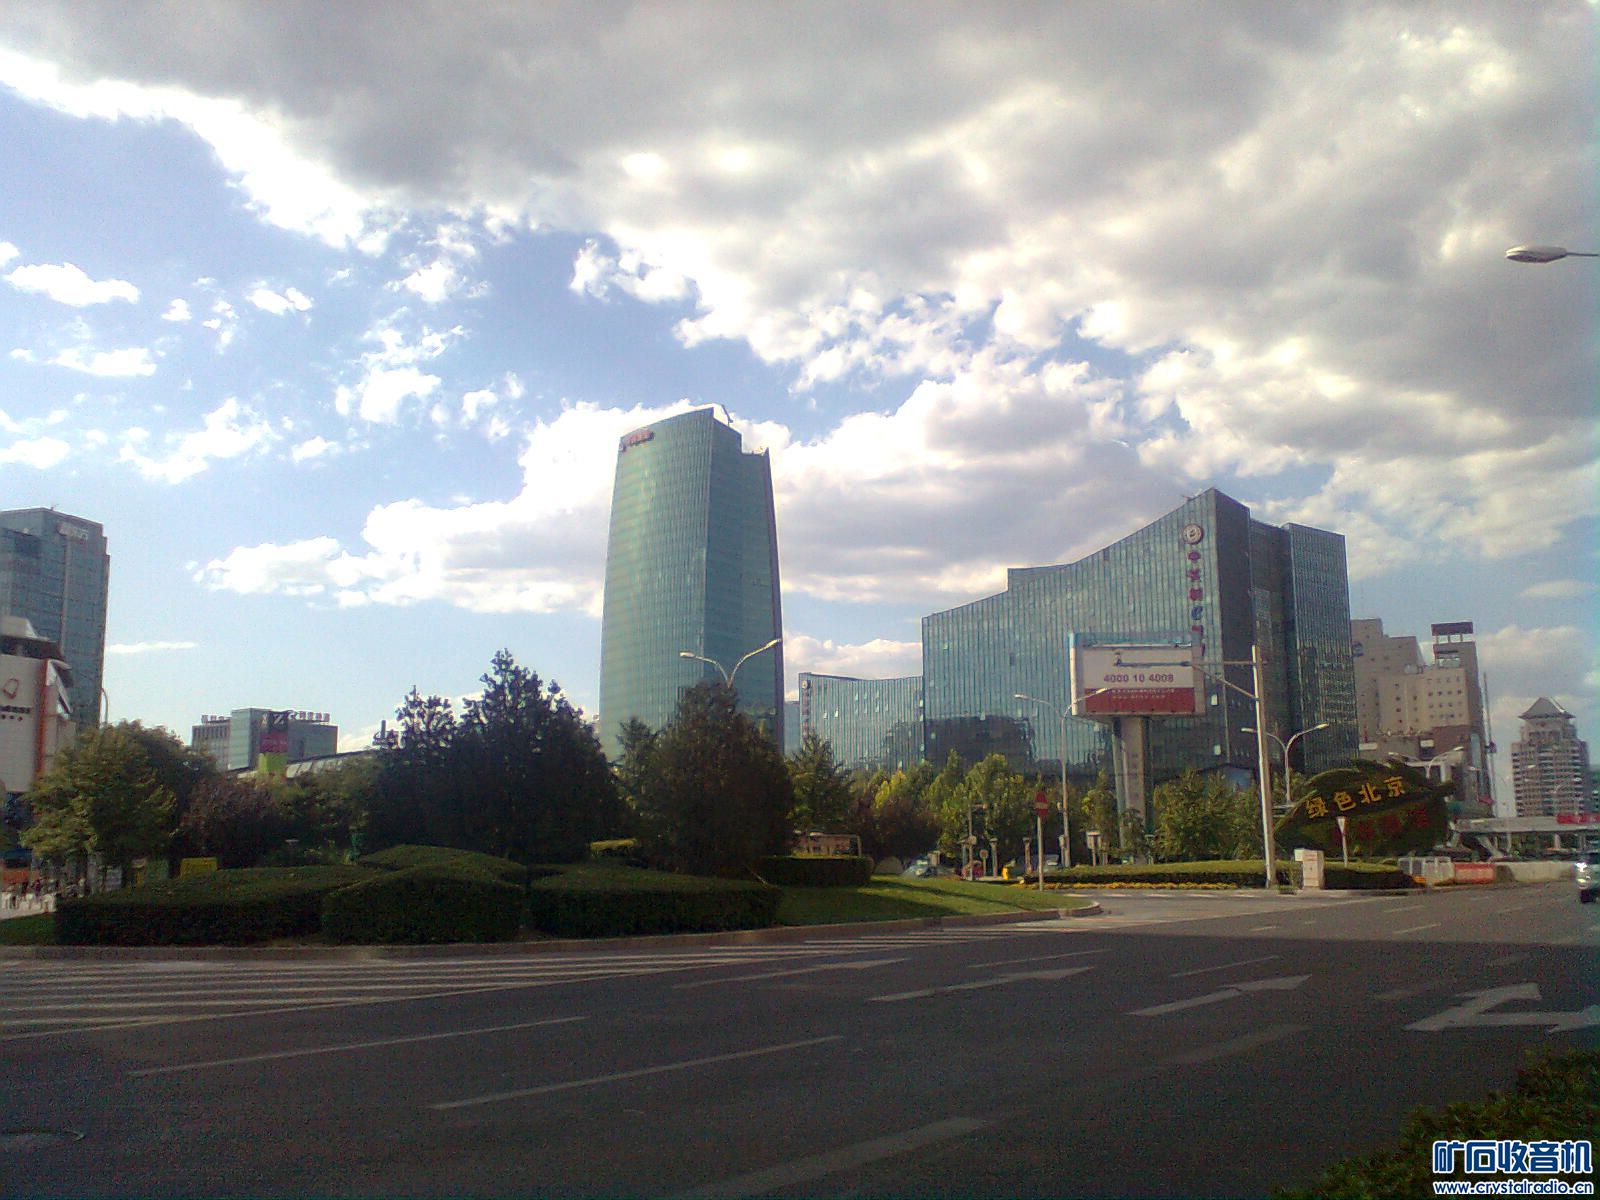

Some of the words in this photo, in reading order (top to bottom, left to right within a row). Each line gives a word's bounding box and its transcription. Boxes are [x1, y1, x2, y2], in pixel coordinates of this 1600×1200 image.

[1133, 673, 1145, 683] 10
[1305, 776, 1405, 819] 绿色北京
